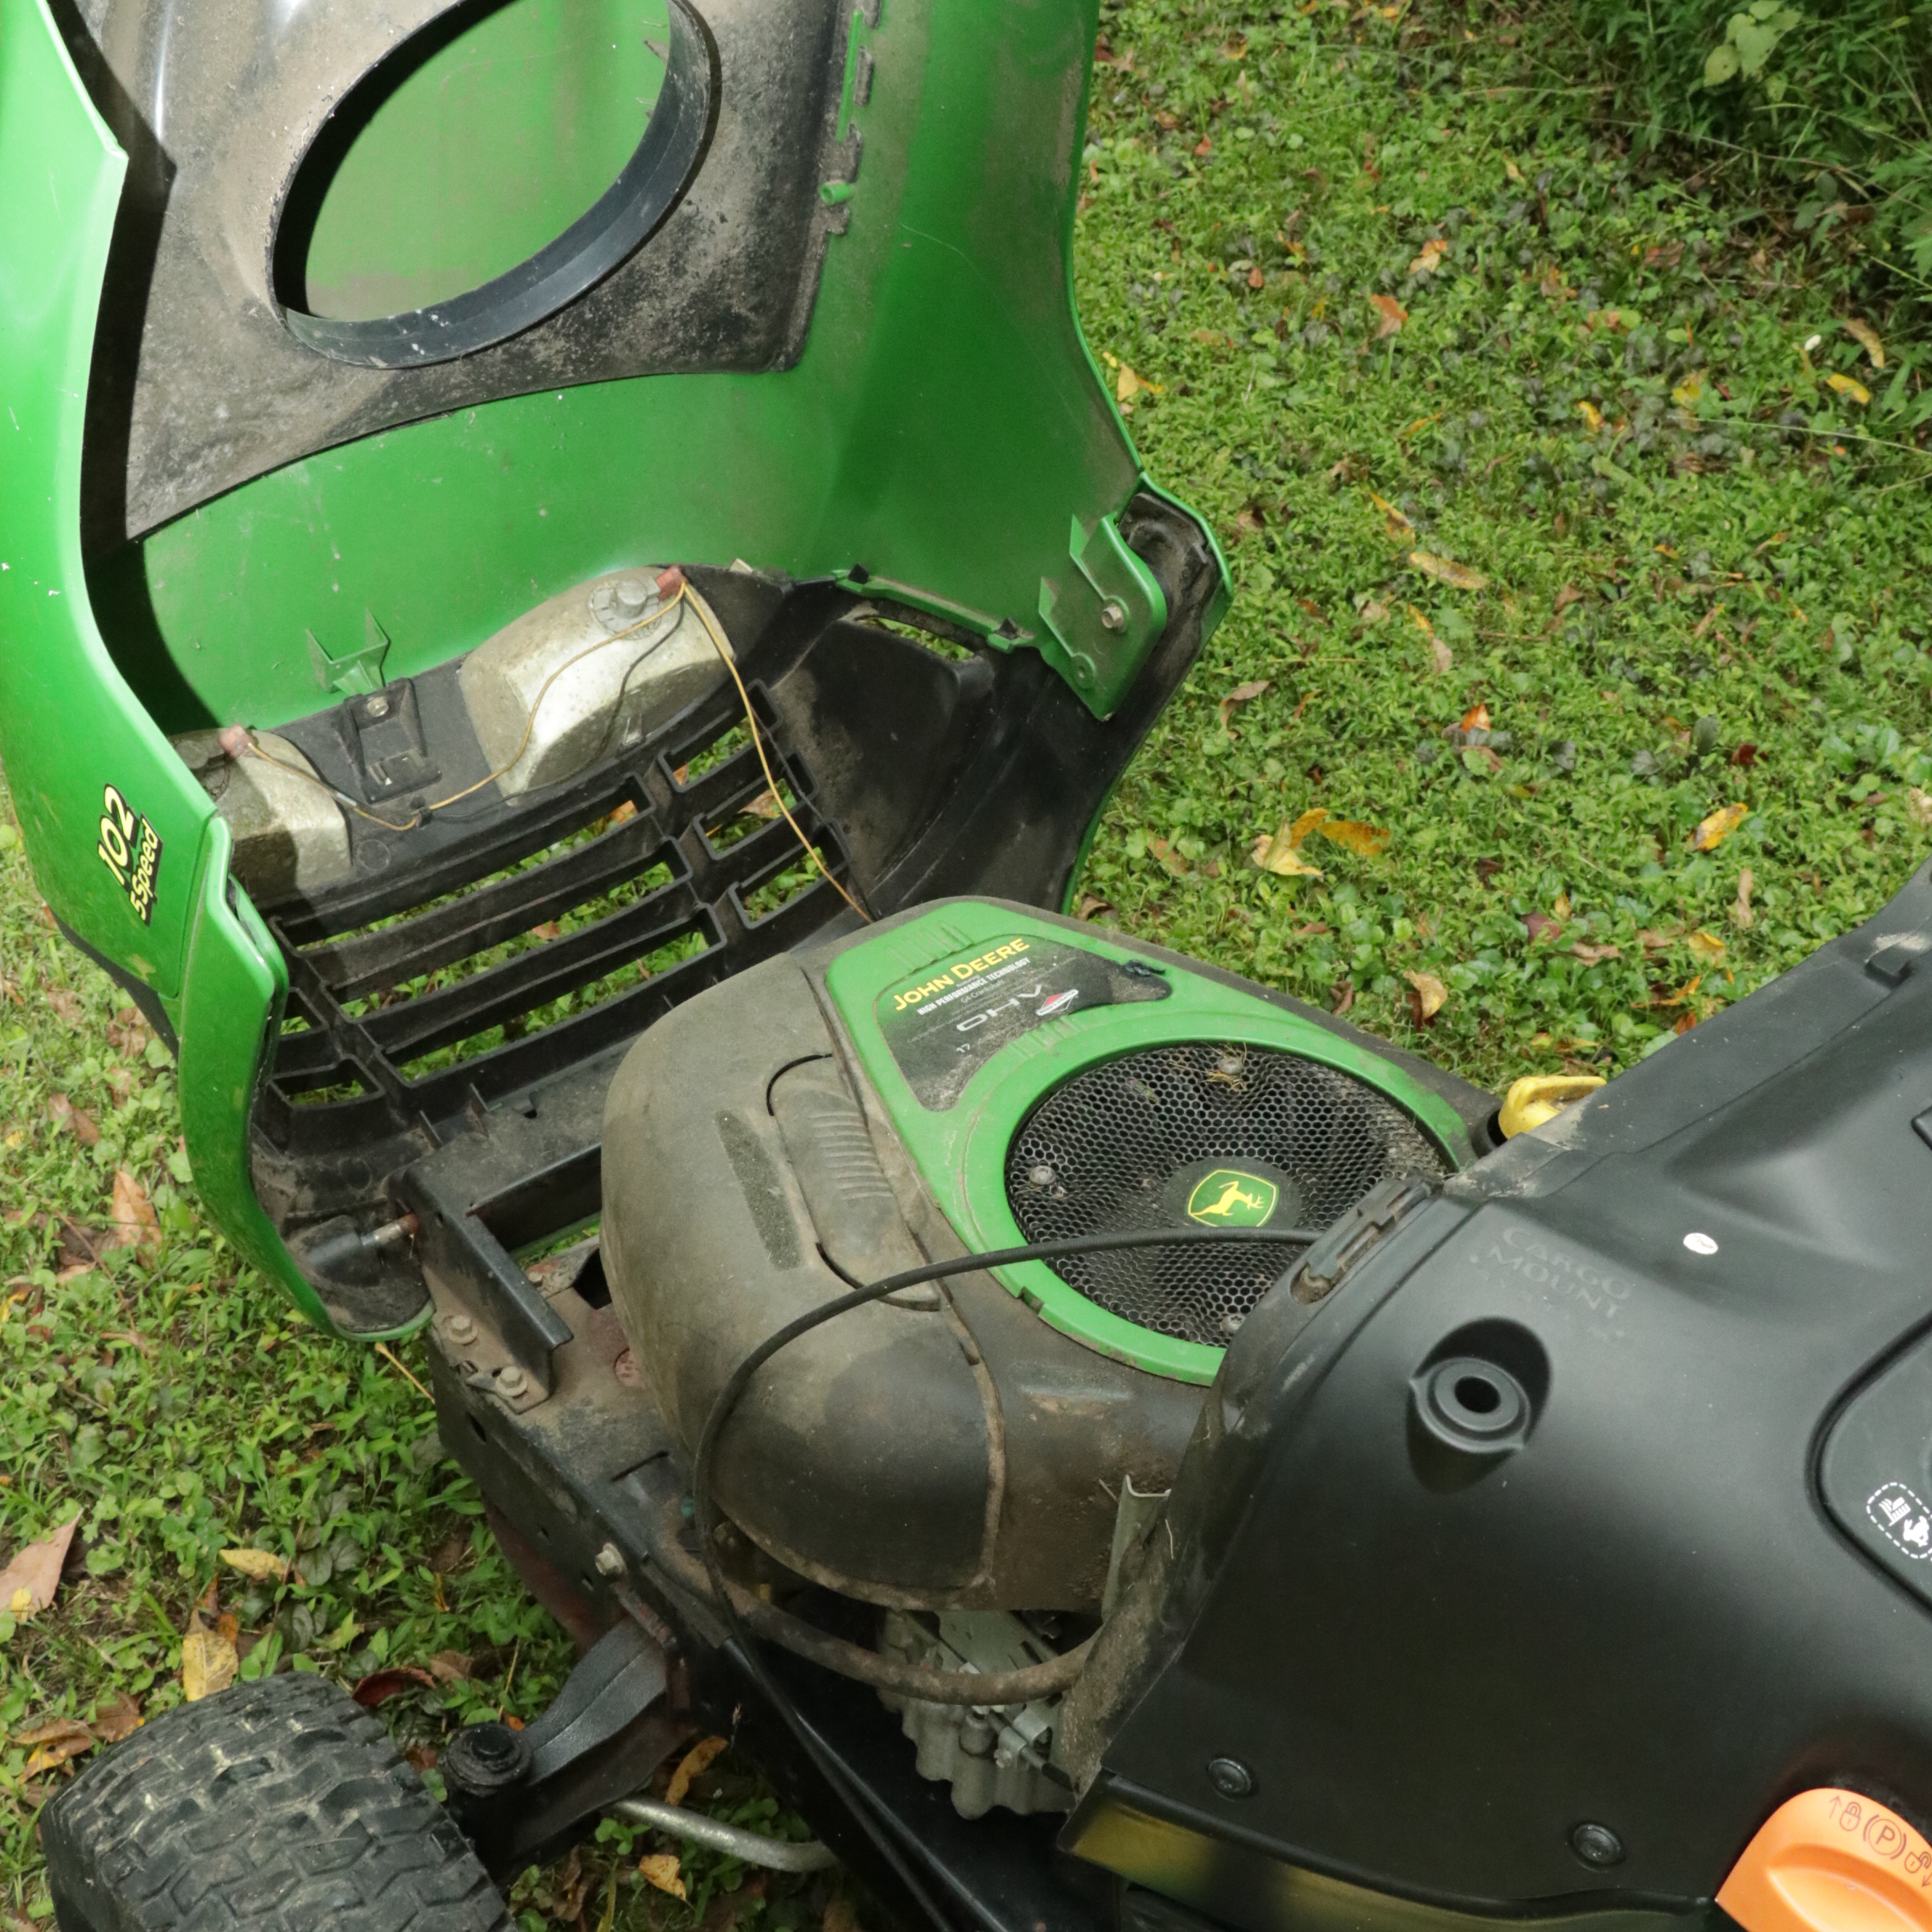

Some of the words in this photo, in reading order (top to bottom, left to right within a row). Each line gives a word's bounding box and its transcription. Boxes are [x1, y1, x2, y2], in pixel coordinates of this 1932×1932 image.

[97, 785, 137, 886] 102
[893, 975, 954, 1011] JOHN
[950, 938, 1030, 980] DEERE
[917, 1002, 938, 1015] HIGH
[936, 978, 989, 1006] PERFORMANCE
[986, 957, 1031, 983] TECHNOLOGY
[970, 979, 1005, 999] Crankshaft
[956, 983, 1042, 1032] OHV
[956, 1042, 971, 1053] 17
[1488, 1245, 1621, 1319] MOUNT
[1504, 1226, 1632, 1301] CARGO
